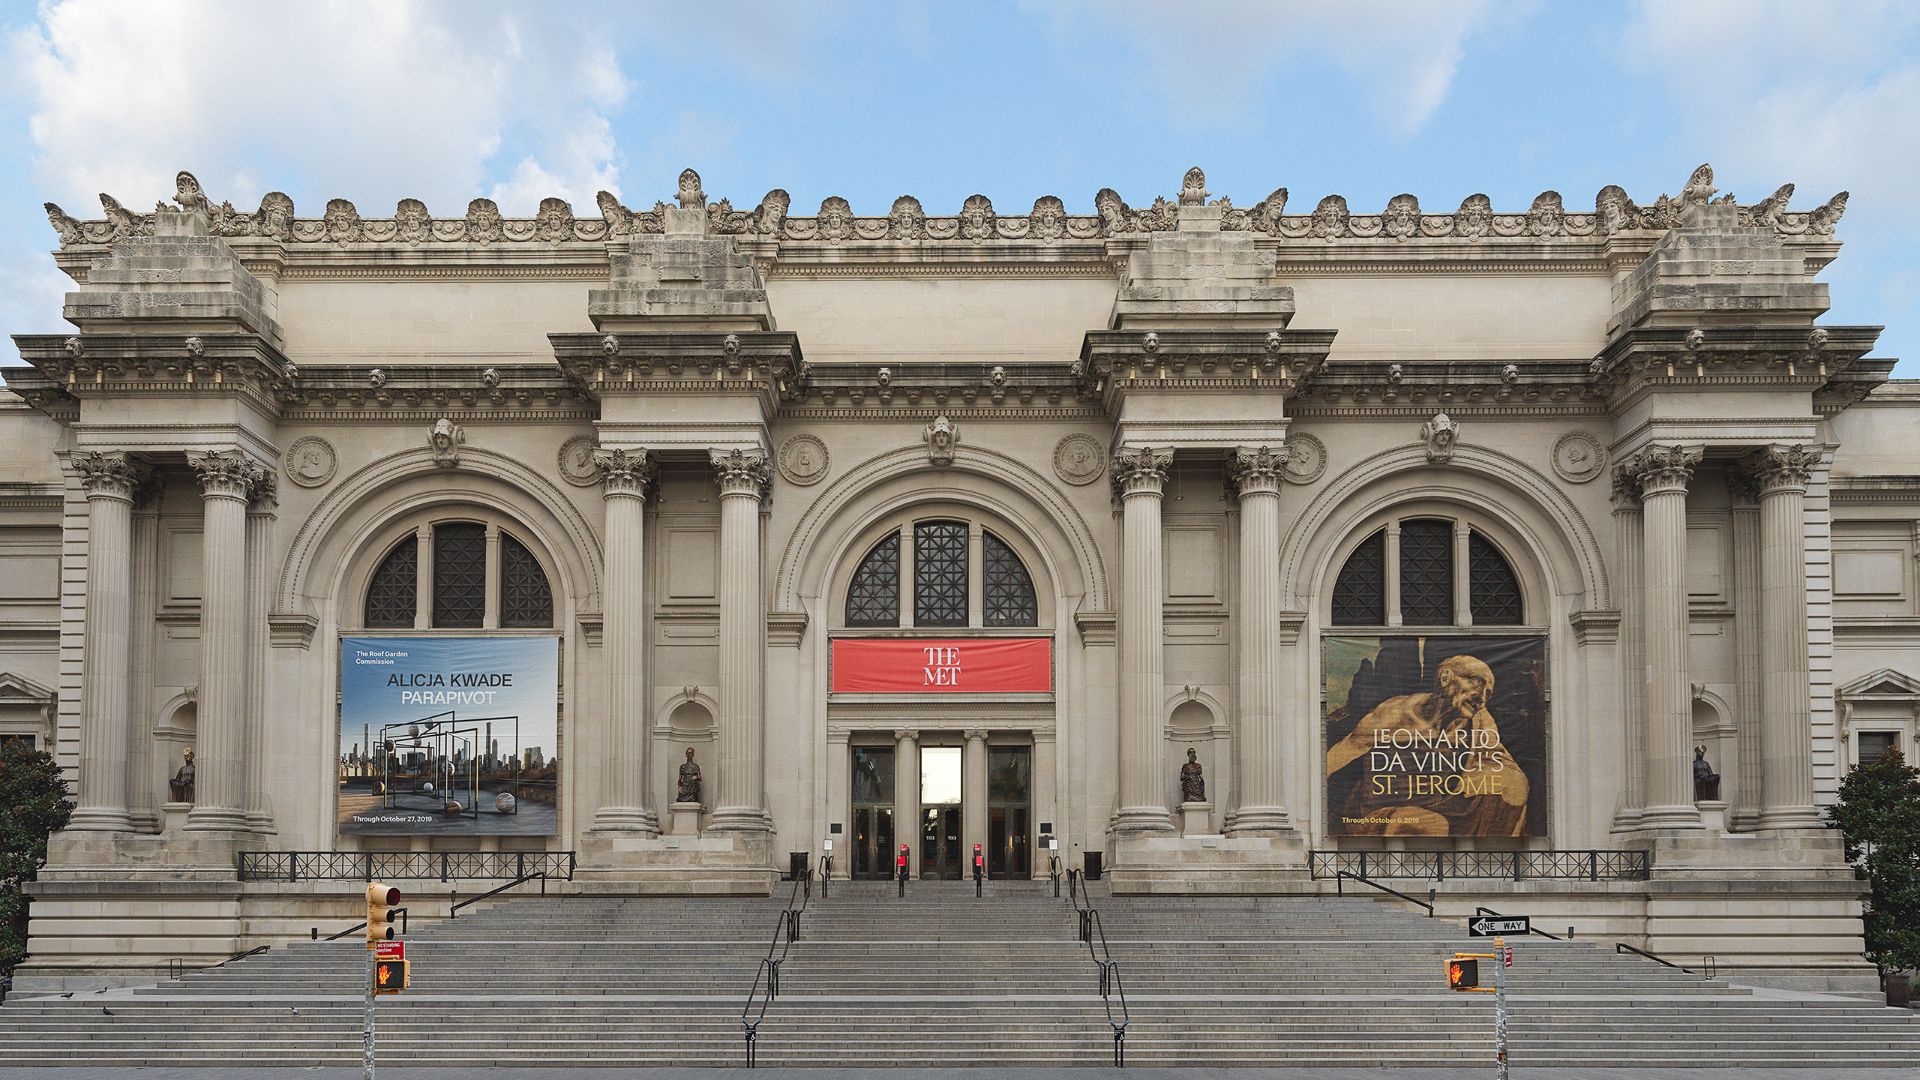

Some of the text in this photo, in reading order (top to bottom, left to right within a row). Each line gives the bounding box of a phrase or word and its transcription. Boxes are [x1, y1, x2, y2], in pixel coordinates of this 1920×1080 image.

[923, 647, 961, 666] THE
[387, 673, 513, 687] ALICJA KWADE
[922, 667, 962, 686] MET
[401, 691, 497, 705] PARAPIVOT
[1373, 728, 1500, 749] LEONARDO
[1370, 750, 1504, 773] DA VINCI'S
[1372, 774, 1503, 800] ST. JEROME
[352, 815, 433, 824] Through October 27, 2019
[1341, 816, 1370, 825] Through
[1370, 816, 1396, 824] October
[1478, 922, 1522, 930] ONE WAY
